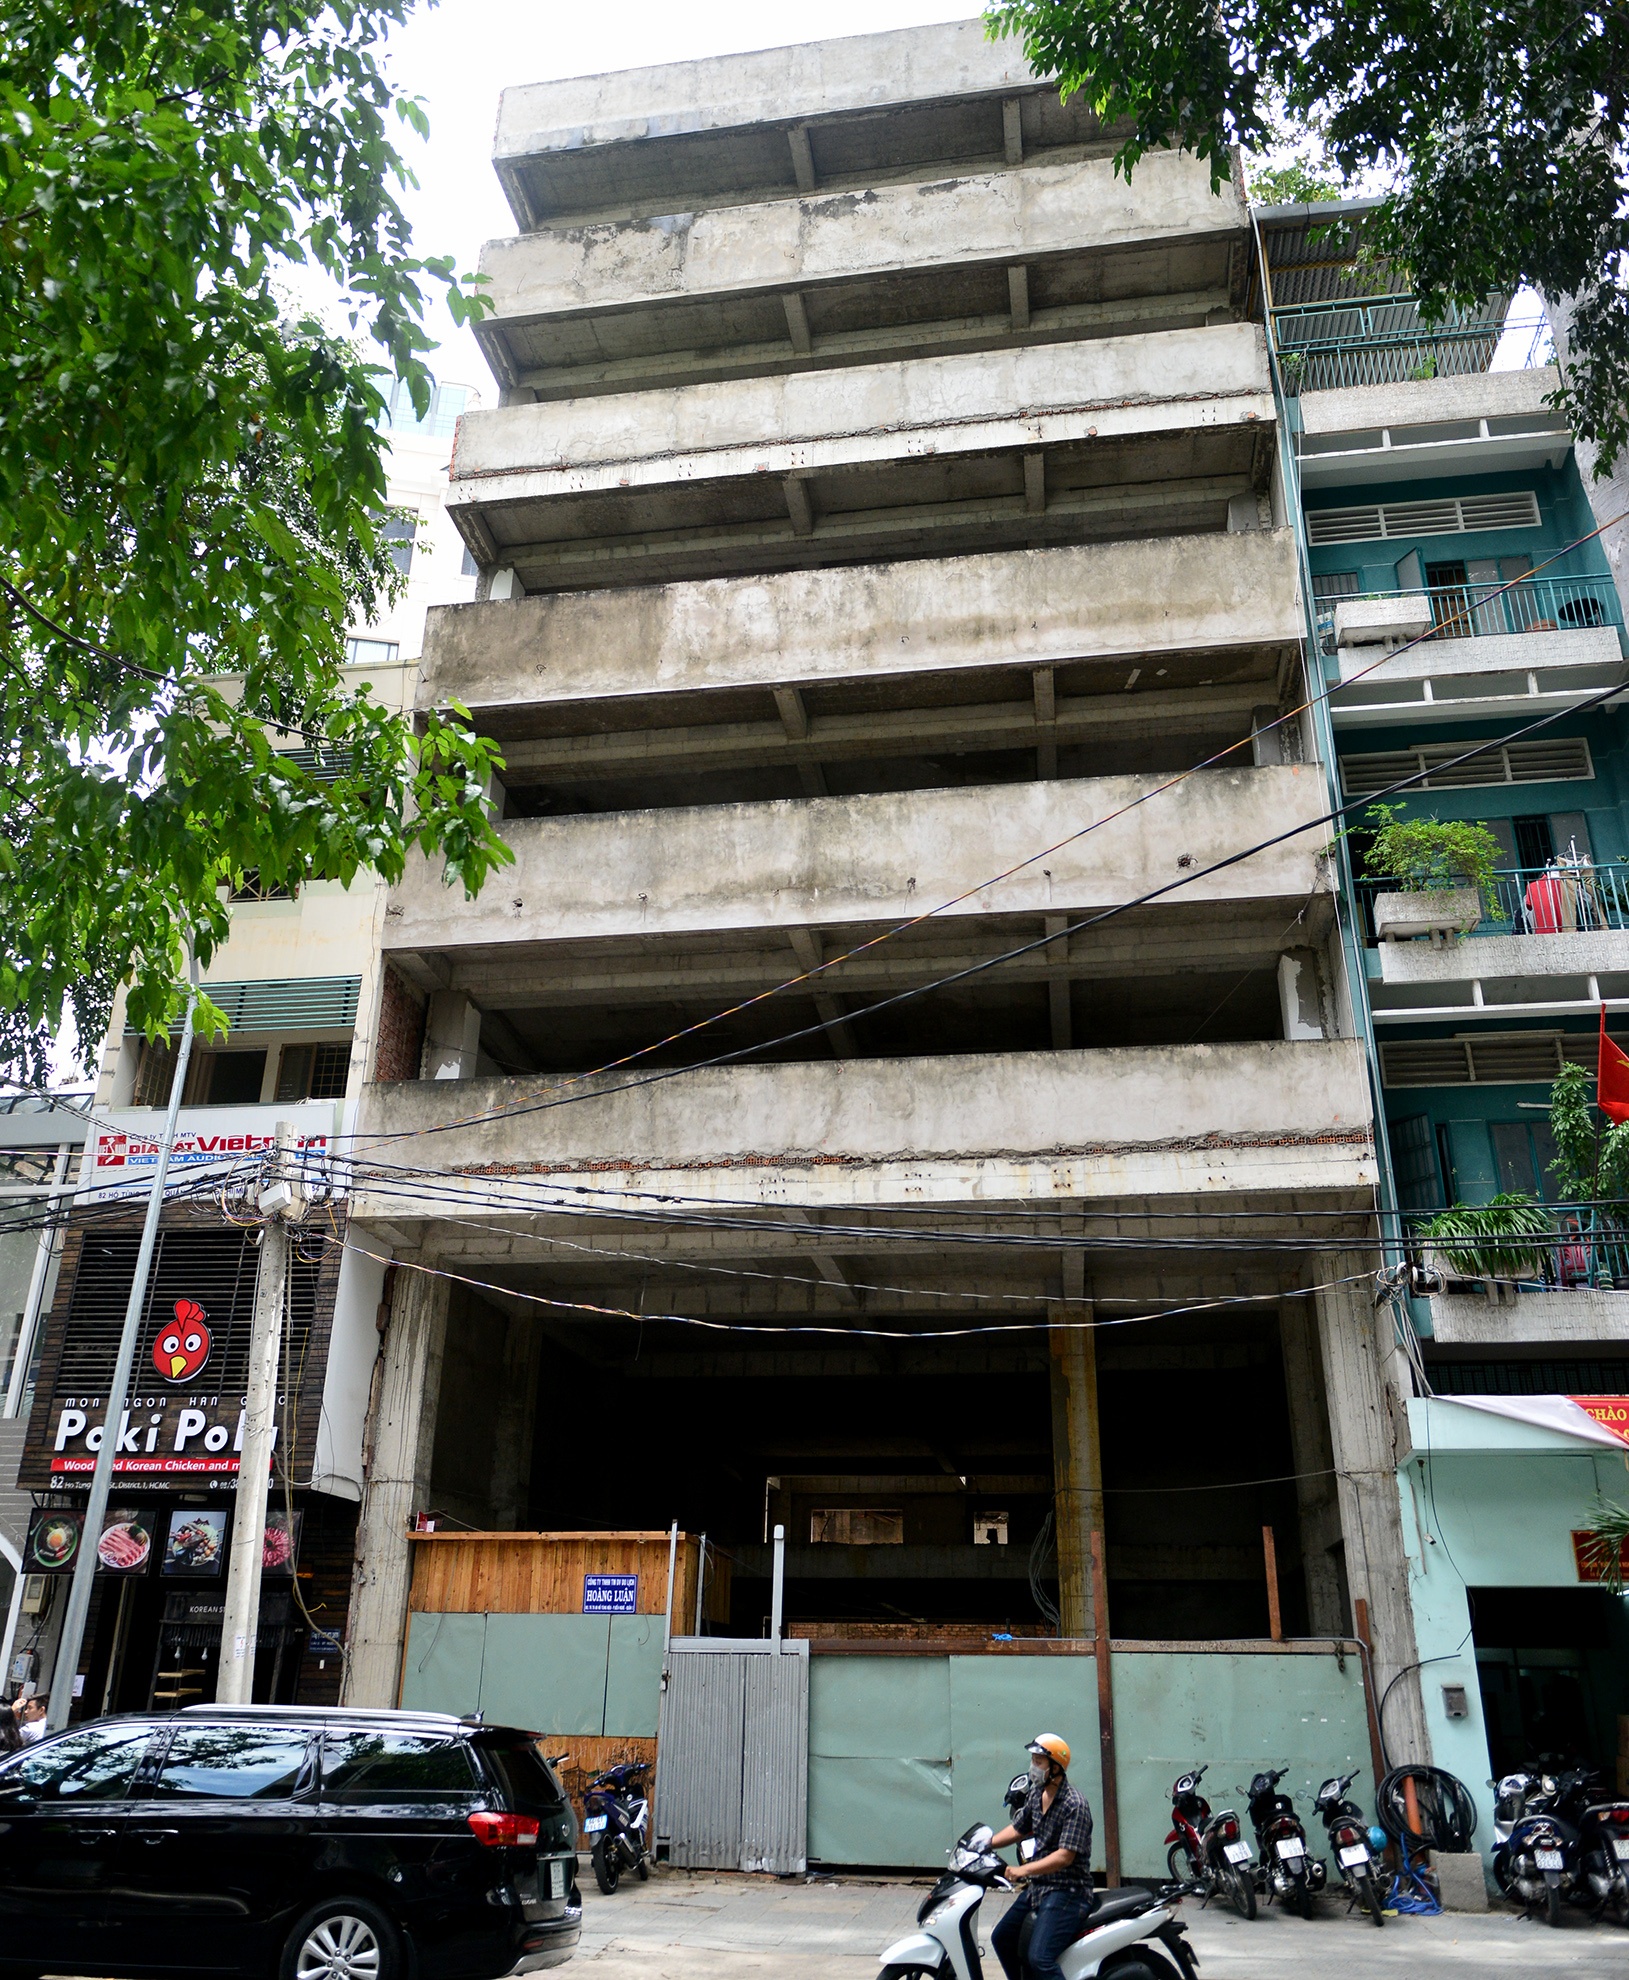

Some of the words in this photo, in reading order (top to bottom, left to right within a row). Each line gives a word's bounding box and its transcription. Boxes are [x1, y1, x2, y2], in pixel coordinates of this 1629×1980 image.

[130, 1155, 185, 1165] VIETAM
[1585, 1405, 1628, 1421] CHÀO
[64, 1461, 95, 1470] Wood
[125, 1460, 162, 1470] Korean
[165, 1460, 205, 1471] Chicken
[208, 1461, 229, 1470] and
[50, 1475, 65, 1489] 82
[148, 1481, 171, 1489] HCMC
[587, 1587, 612, 1602] HOÀNG
[614, 1587, 634, 1604] LUẬN
[189, 1605, 218, 1613] KOREAN
